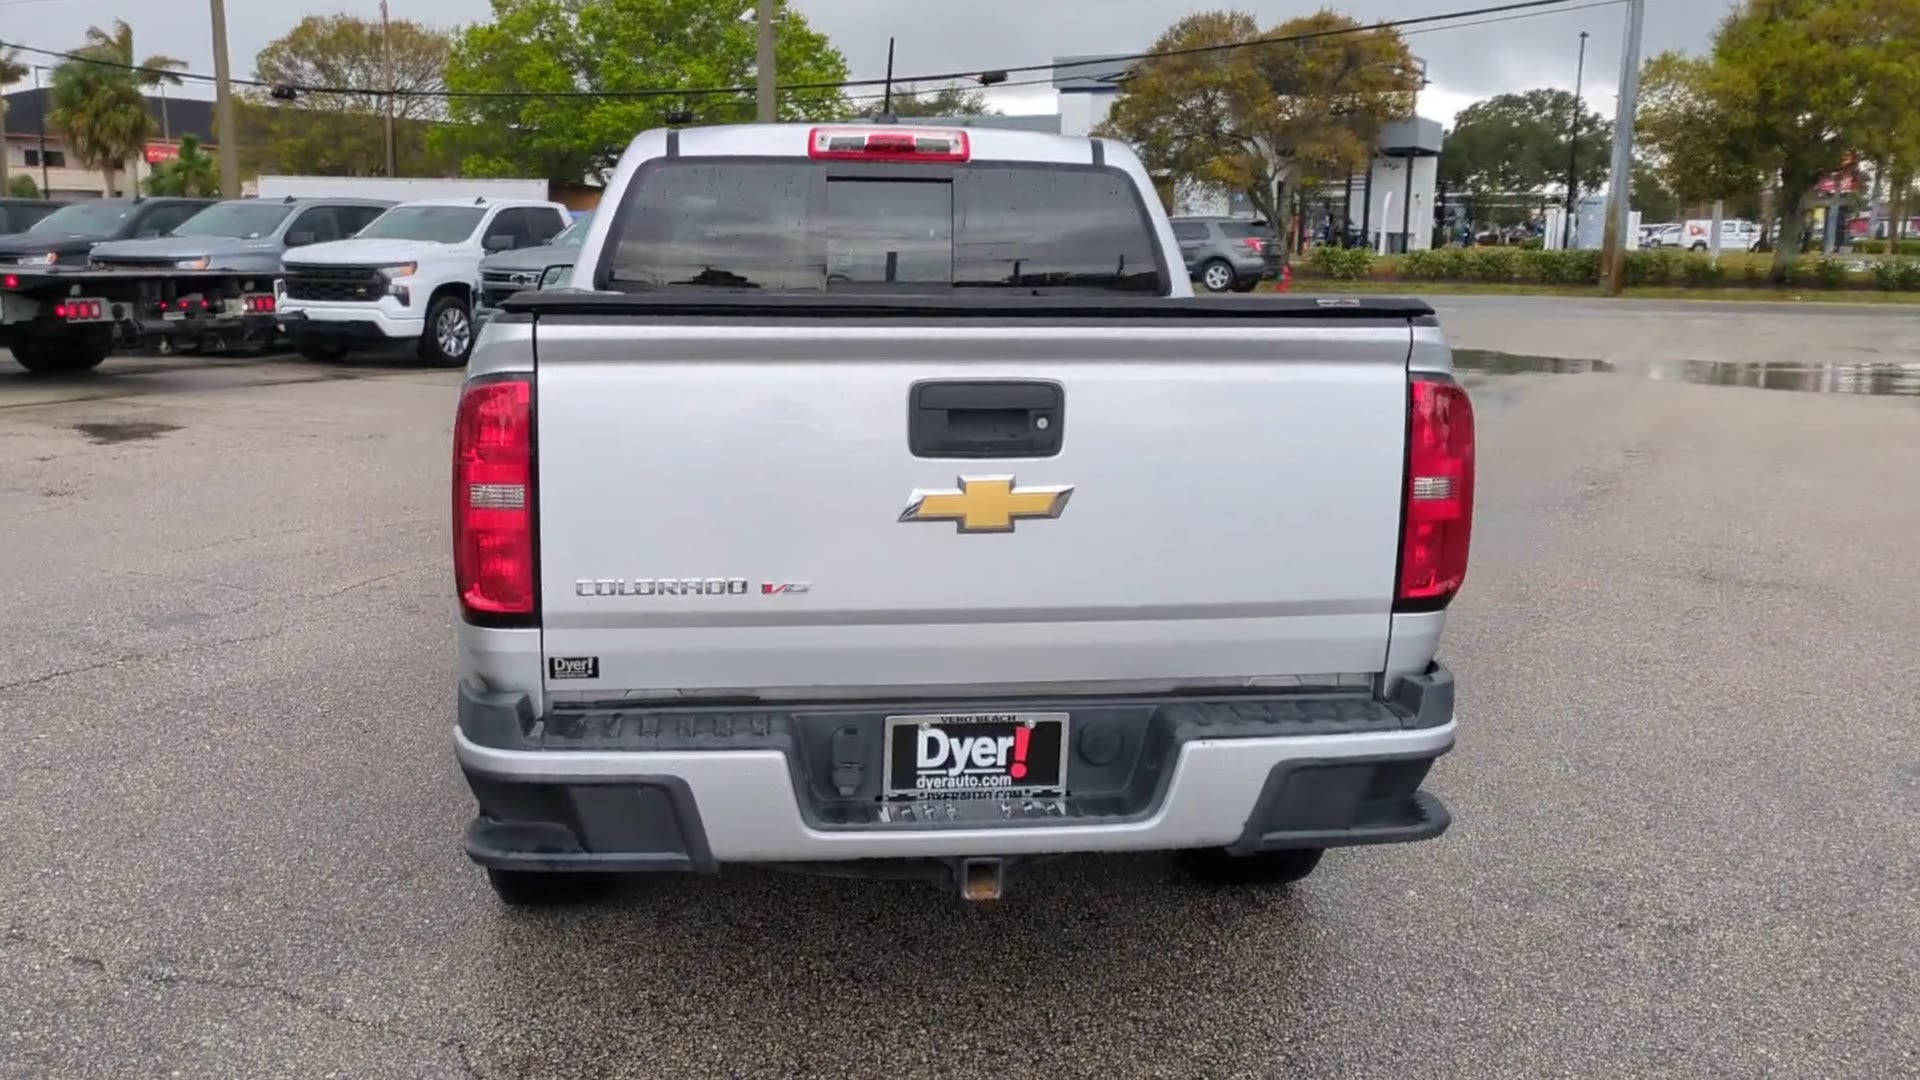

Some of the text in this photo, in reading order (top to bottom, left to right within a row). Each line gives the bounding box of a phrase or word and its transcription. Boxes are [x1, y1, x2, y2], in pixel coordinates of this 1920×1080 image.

[575, 577, 748, 597] COLORADO
[554, 657, 594, 674] Dyer!
[940, 714, 1017, 724] VERO BEACH
[916, 726, 1032, 779] Dyer!
[916, 775, 1012, 789] dyerauto.com
[927, 789, 1023, 800] DYERAUTOCOM
